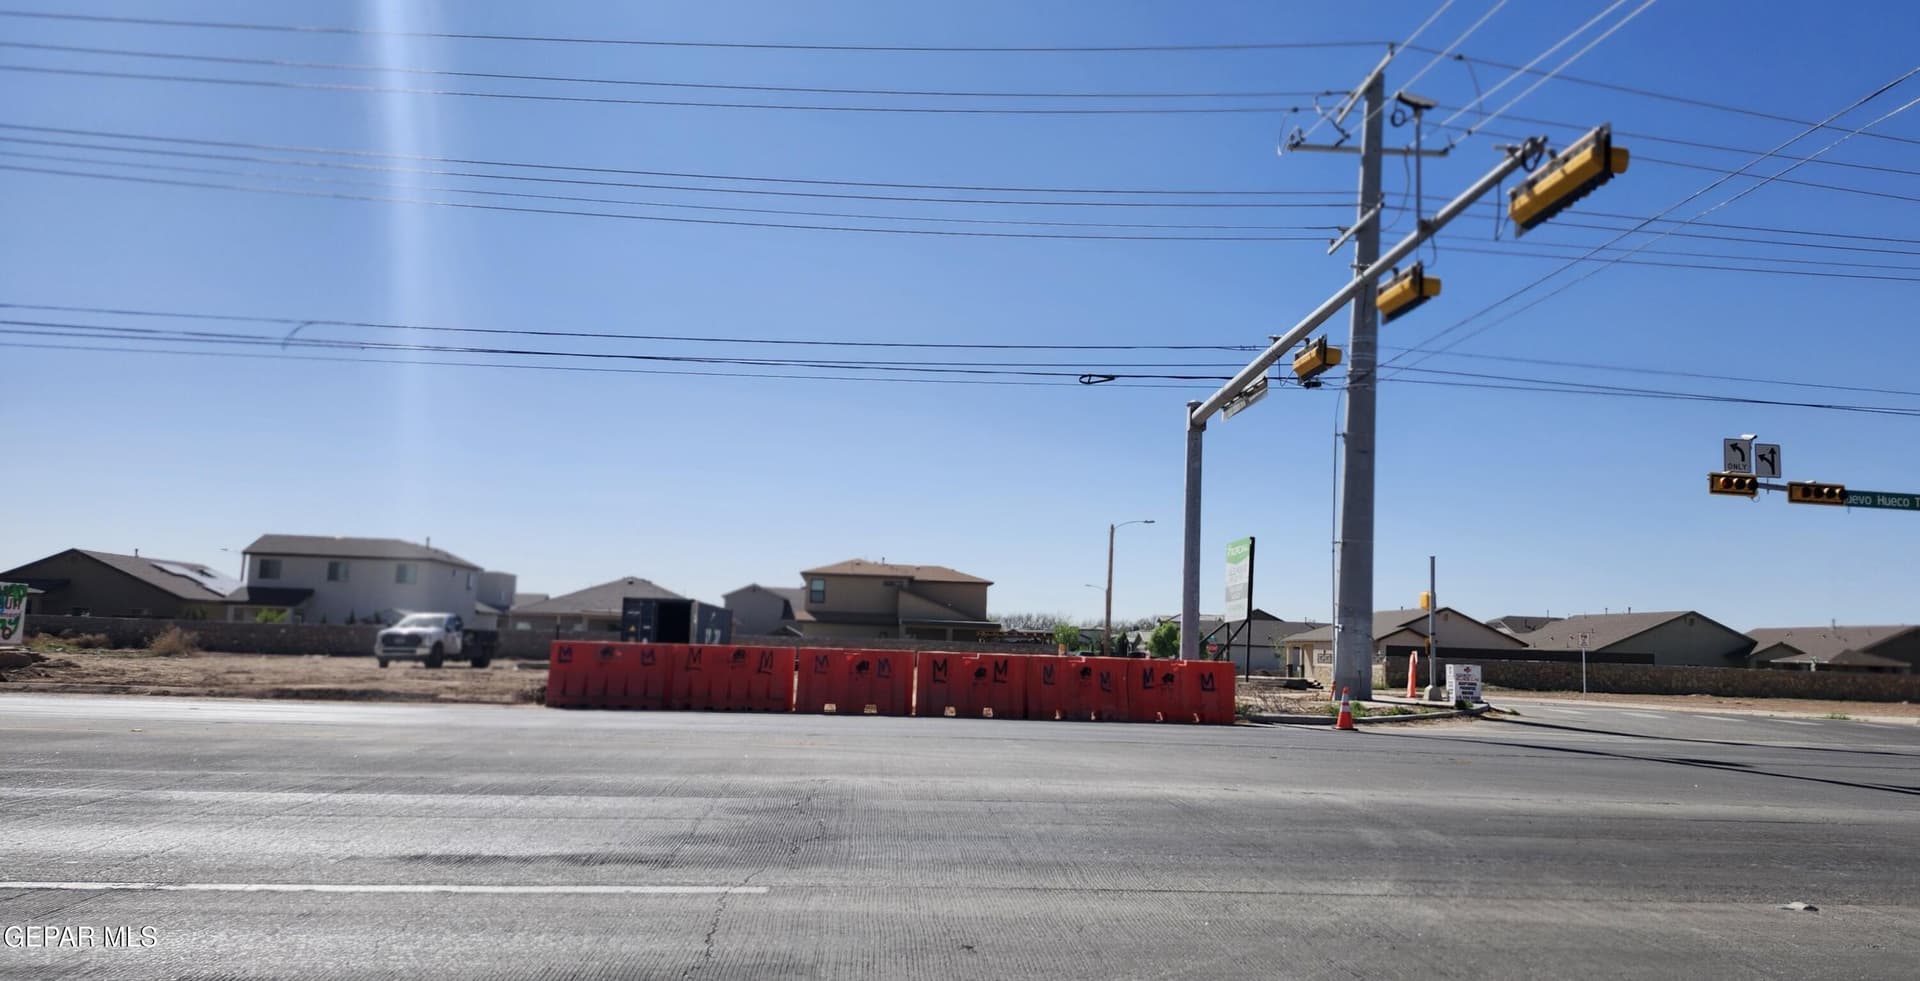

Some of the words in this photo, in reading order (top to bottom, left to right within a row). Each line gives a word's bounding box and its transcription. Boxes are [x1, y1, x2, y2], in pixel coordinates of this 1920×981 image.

[1727, 463, 1747, 471] ONLY
[1847, 495, 1872, 505] uevo
[1877, 495, 1910, 507] Hueco
